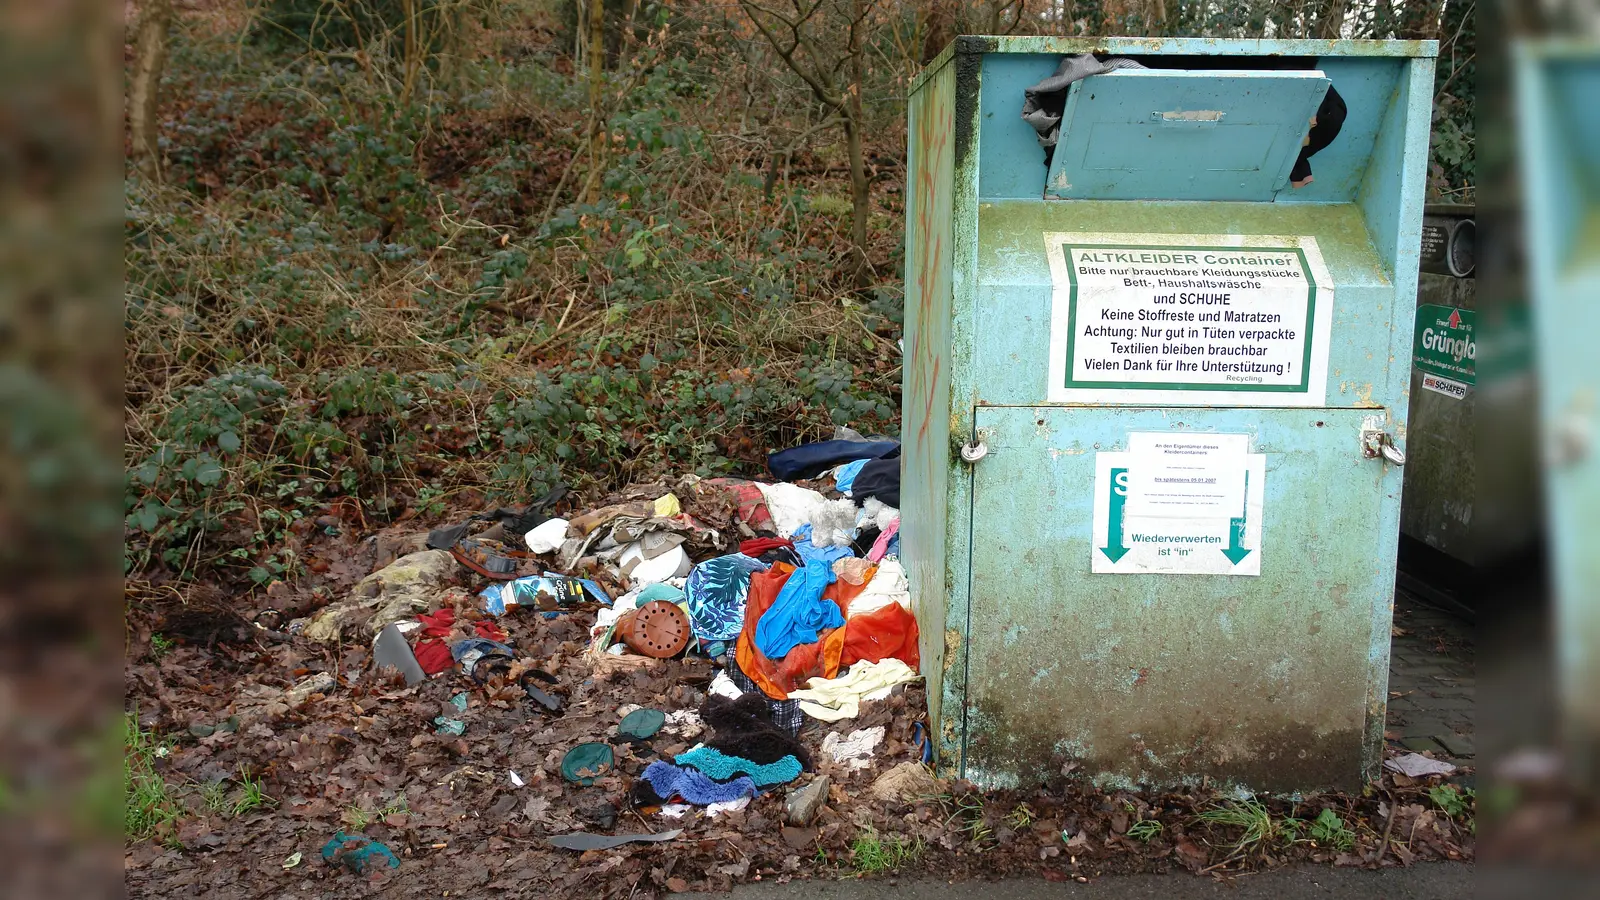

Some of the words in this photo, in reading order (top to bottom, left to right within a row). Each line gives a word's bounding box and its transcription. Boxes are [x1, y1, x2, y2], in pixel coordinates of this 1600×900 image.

[1080, 252, 1198, 265] ALTKLEIDER
[1203, 253, 1293, 267] Container
[1079, 266, 1106, 276] Bitte
[1110, 267, 1129, 276] nur
[1132, 267, 1199, 277] brauchbare
[1202, 268, 1300, 280] Kleidungsstücke
[1123, 278, 1155, 289] Bett-,
[1158, 278, 1261, 290] Haushaltswäsche
[1153, 293, 1176, 305] und
[1179, 293, 1231, 306] SCHUHE
[1101, 308, 1134, 321] Keine
[1138, 309, 1195, 322] Stoffreste
[1198, 310, 1220, 322] und
[1224, 310, 1281, 323] Matratzen
[1084, 325, 1138, 340] Achtung:
[1141, 326, 1162, 338] Nur
[1165, 327, 1184, 341] gut
[1188, 327, 1199, 339] in
[1202, 326, 1236, 339] Tüten
[1238, 328, 1296, 343] verpackte
[1110, 342, 1159, 355] Textilien
[1162, 342, 1205, 356] bleiben
[1208, 344, 1268, 357] brauchbar
[1084, 358, 1120, 371] Vielen
[1123, 359, 1153, 372] Dank
[1156, 359, 1173, 372] für
[1176, 360, 1198, 372] Ihre
[1201, 360, 1284, 376] Unterstützung
[1226, 374, 1263, 383] Recycling
[1131, 533, 1222, 544] Wiederverwerten
[1158, 546, 1171, 556] ist
